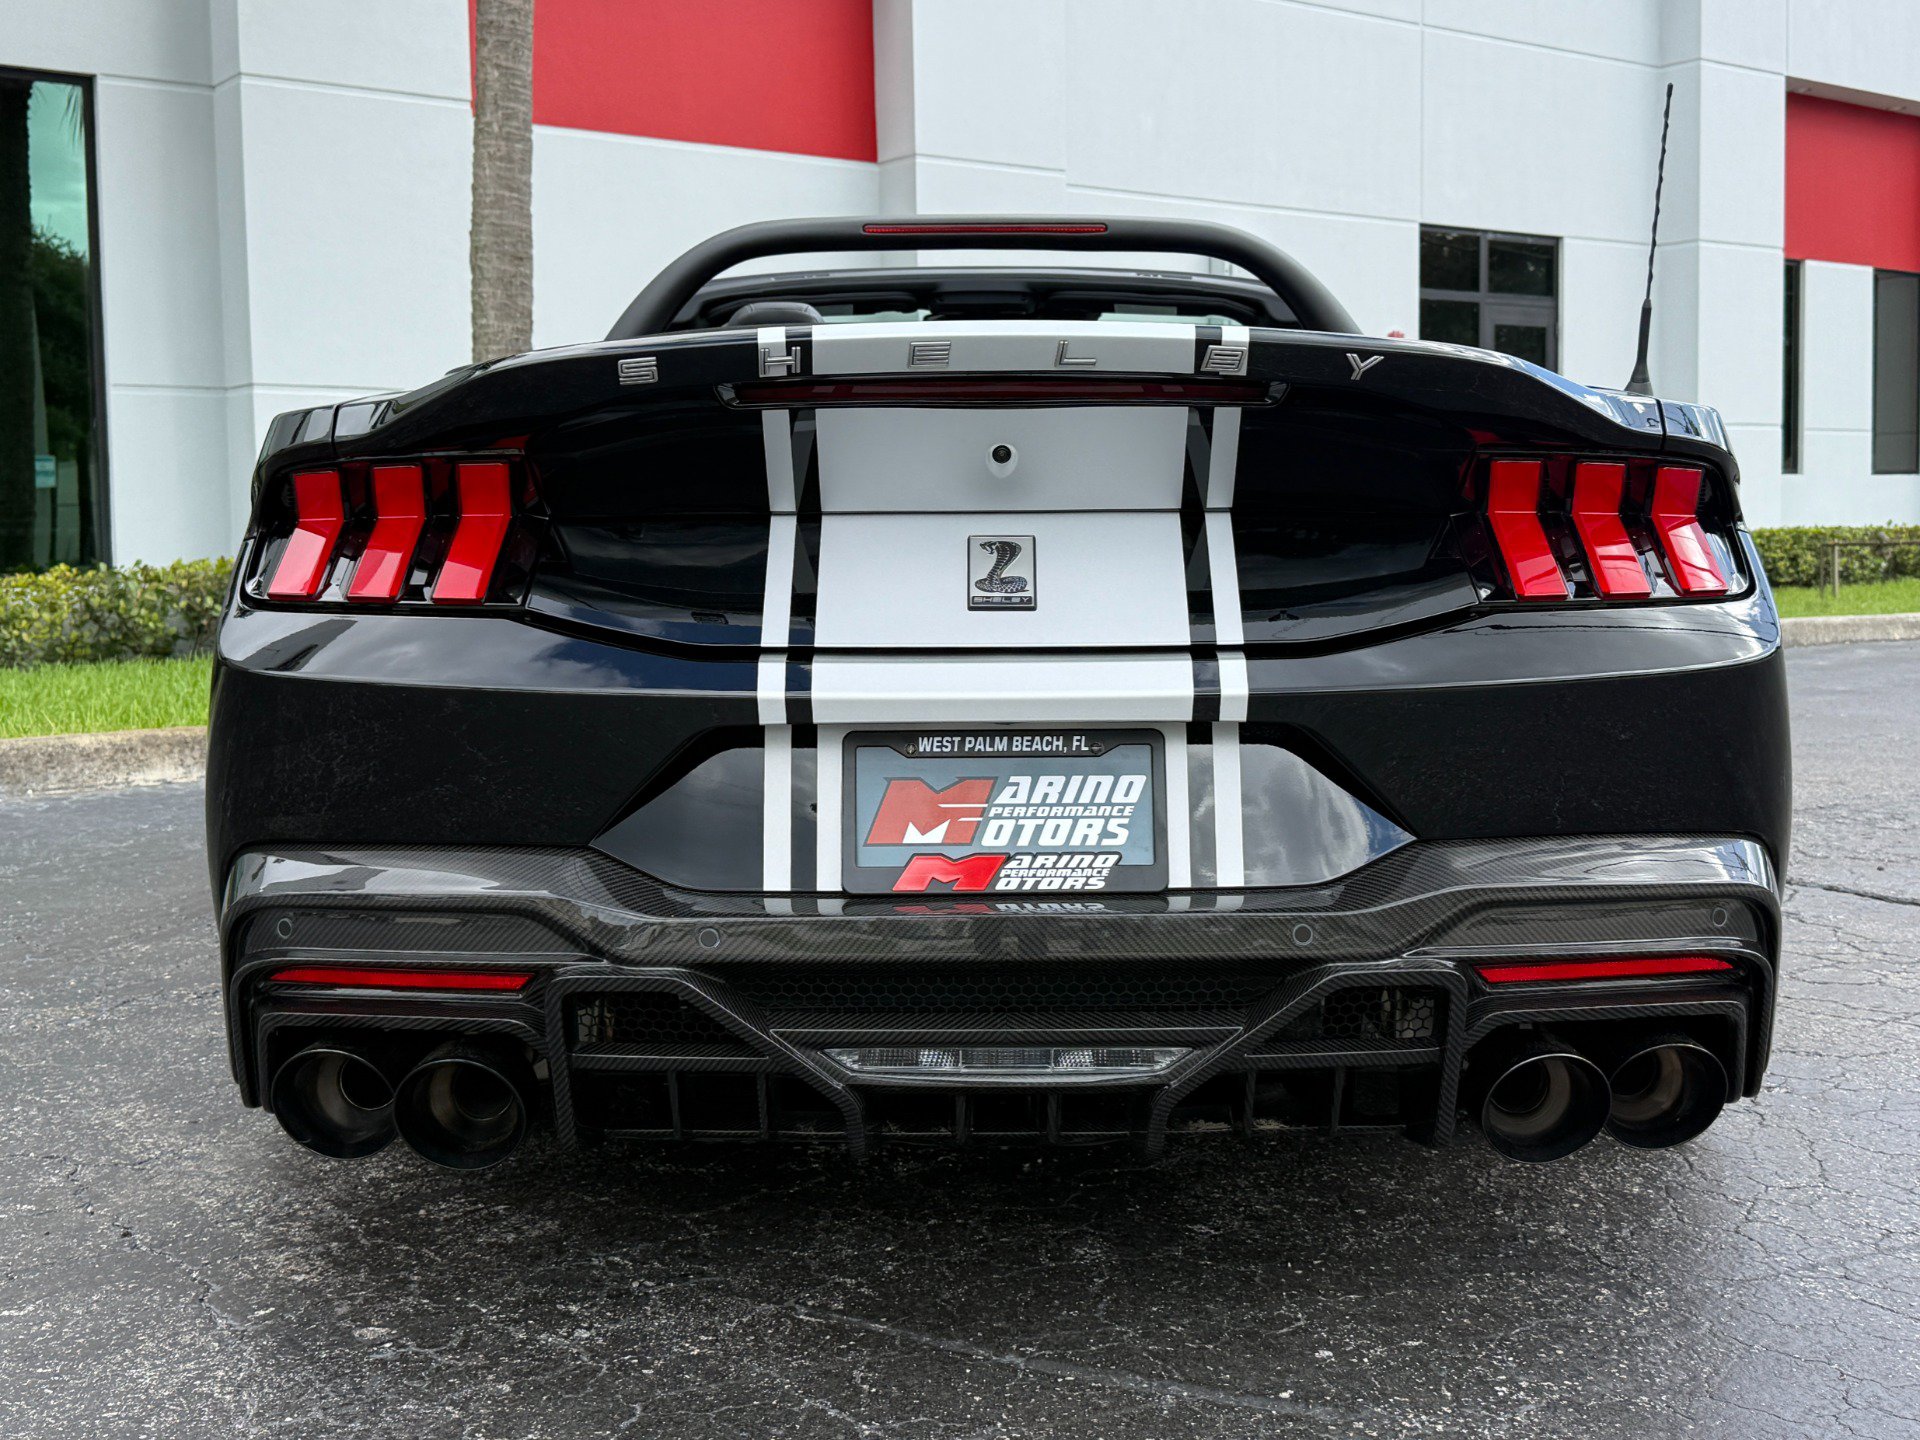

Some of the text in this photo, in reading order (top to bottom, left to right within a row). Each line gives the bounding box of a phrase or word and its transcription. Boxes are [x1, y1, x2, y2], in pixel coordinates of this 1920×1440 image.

[618, 339, 1384, 386] SHELBY
[918, 735, 1089, 753] WEST PALM BEACH, FL
[988, 806, 1134, 817] PERFORMANCE
[1000, 869, 1110, 877] PERFORMANCE
